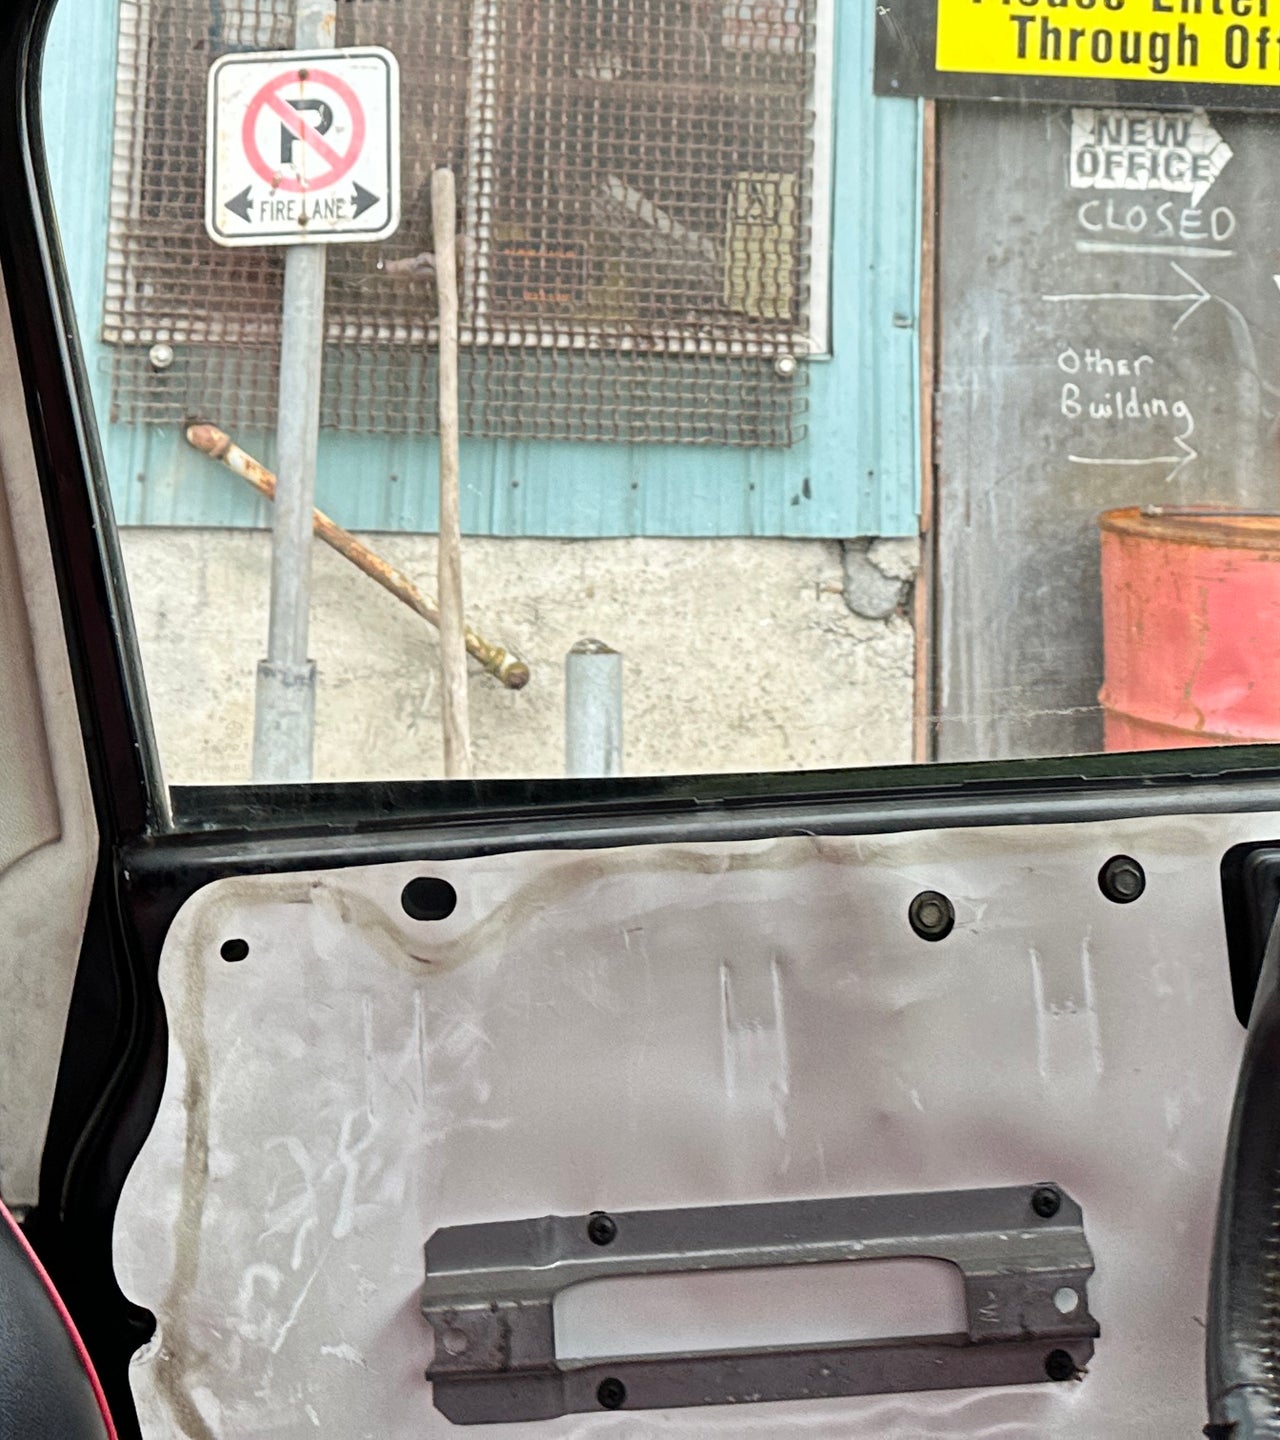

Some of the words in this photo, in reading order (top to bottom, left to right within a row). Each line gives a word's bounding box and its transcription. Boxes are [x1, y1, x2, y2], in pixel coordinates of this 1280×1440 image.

[1009, 14, 1199, 75] Through
[1095, 117, 1192, 147] NEW
[1075, 142, 1212, 183] OFFICE
[259, 198, 297, 222] FIRE
[1077, 197, 1237, 242] CLOSED
[1056, 346, 1155, 377] Other
[1060, 382, 1195, 440] Building
